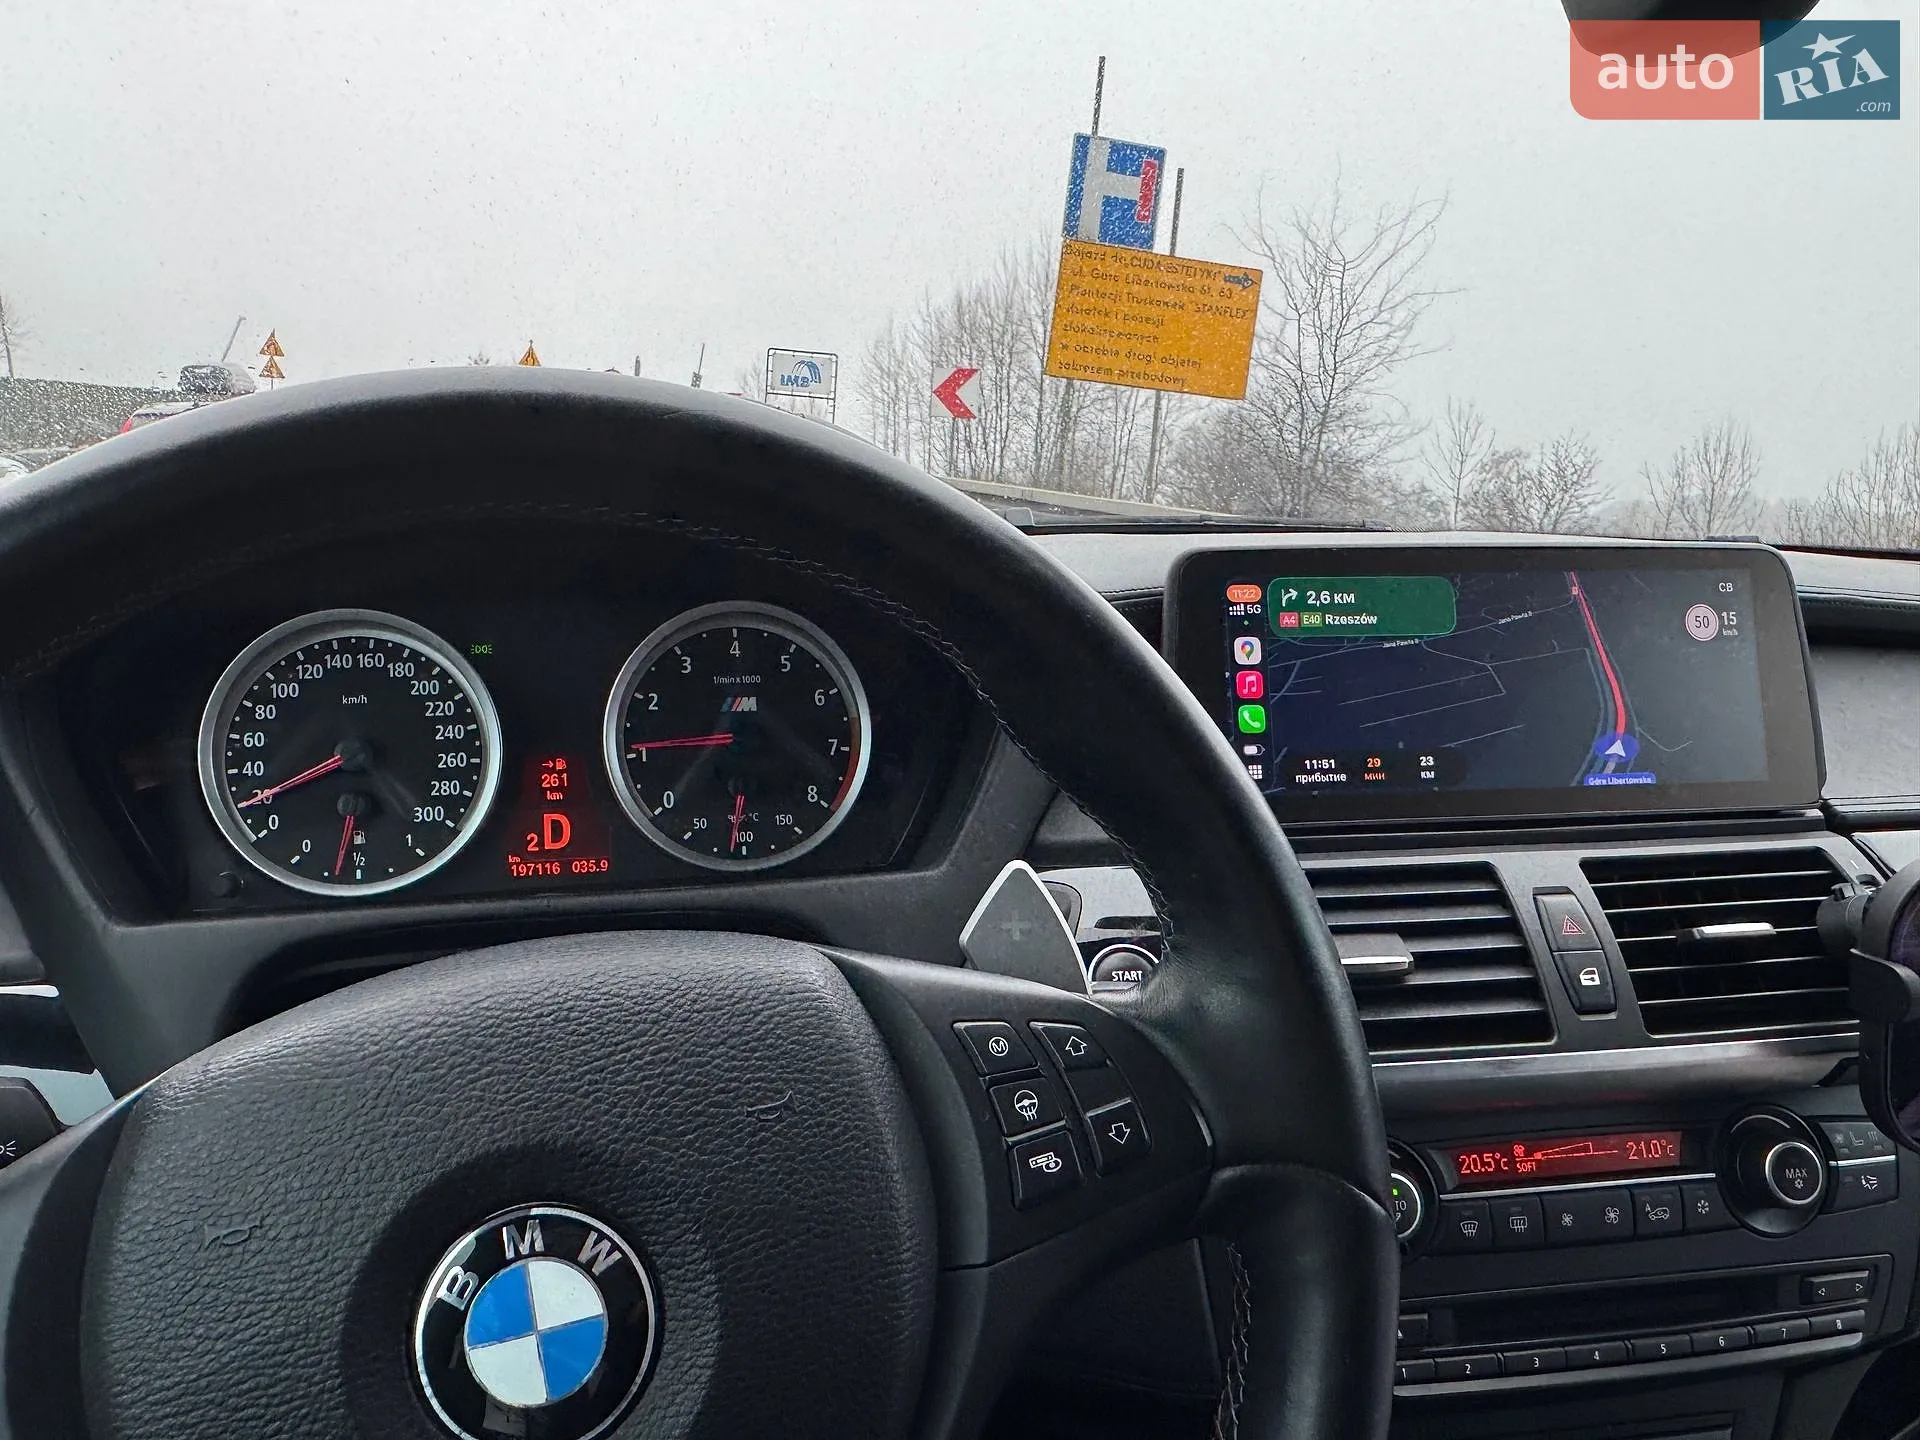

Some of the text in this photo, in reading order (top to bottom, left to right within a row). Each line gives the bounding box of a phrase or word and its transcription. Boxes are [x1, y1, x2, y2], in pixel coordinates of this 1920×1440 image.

[1306, 591, 1331, 607] 2,6
[1247, 604, 1262, 614] 5G
[1282, 614, 1378, 626] A4 E40 Rzeszów
[1694, 616, 1710, 629] 50
[1721, 611, 1737, 625] 15
[729, 640, 741, 657] 4
[324, 654, 353, 669] 140
[356, 653, 385, 668] 160
[680, 656, 692, 674] 3
[780, 655, 792, 672] 5
[296, 664, 324, 680] 120
[387, 662, 415, 678] 180
[270, 682, 299, 699] 100
[410, 680, 440, 695] 200
[342, 694, 368, 706] km/h
[647, 693, 659, 711] 2
[814, 688, 825, 706] 6
[254, 704, 276, 720] 80
[424, 701, 455, 717] 220
[242, 731, 265, 747] 60
[434, 724, 465, 740] 240
[640, 746, 647, 762] 1
[828, 738, 839, 756] 7
[437, 752, 467, 768] 260
[1304, 759, 1336, 769] 11:51
[1366, 757, 1381, 768] 29
[1419, 756, 1435, 766] 23
[242, 761, 265, 777] 40
[1364, 772, 1385, 781] мин
[541, 773, 568, 788] 261
[1295, 773, 1347, 784] прибытие
[430, 780, 460, 796] 280
[546, 790, 563, 800] km
[807, 785, 818, 802] 8
[662, 790, 675, 809] 0
[413, 806, 444, 822] 300
[775, 814, 793, 825] 150
[269, 814, 279, 830] 0
[693, 817, 707, 830] 50
[526, 813, 571, 851] 2 D
[736, 831, 753, 843] 100
[302, 839, 312, 853] 0
[405, 834, 412, 846] 1
[508, 855, 521, 863] km
[511, 860, 608, 877] 197116 035.9
[1111, 970, 1143, 982] START
[1516, 1161, 1537, 1173] SOFT
[1785, 1168, 1808, 1179] MAX
[435, 1219, 623, 1311] BMW
[1835, 1319, 1842, 1330] 8
[1781, 1328, 1787, 1338] 7
[1660, 1344, 1667, 1354] 5
[1718, 1336, 1725, 1347] 6
[1533, 1357, 1539, 1367] 3
[1593, 1350, 1600, 1361] 4
[1402, 1367, 1407, 1378] 1
[1465, 1364, 1471, 1374] 2
